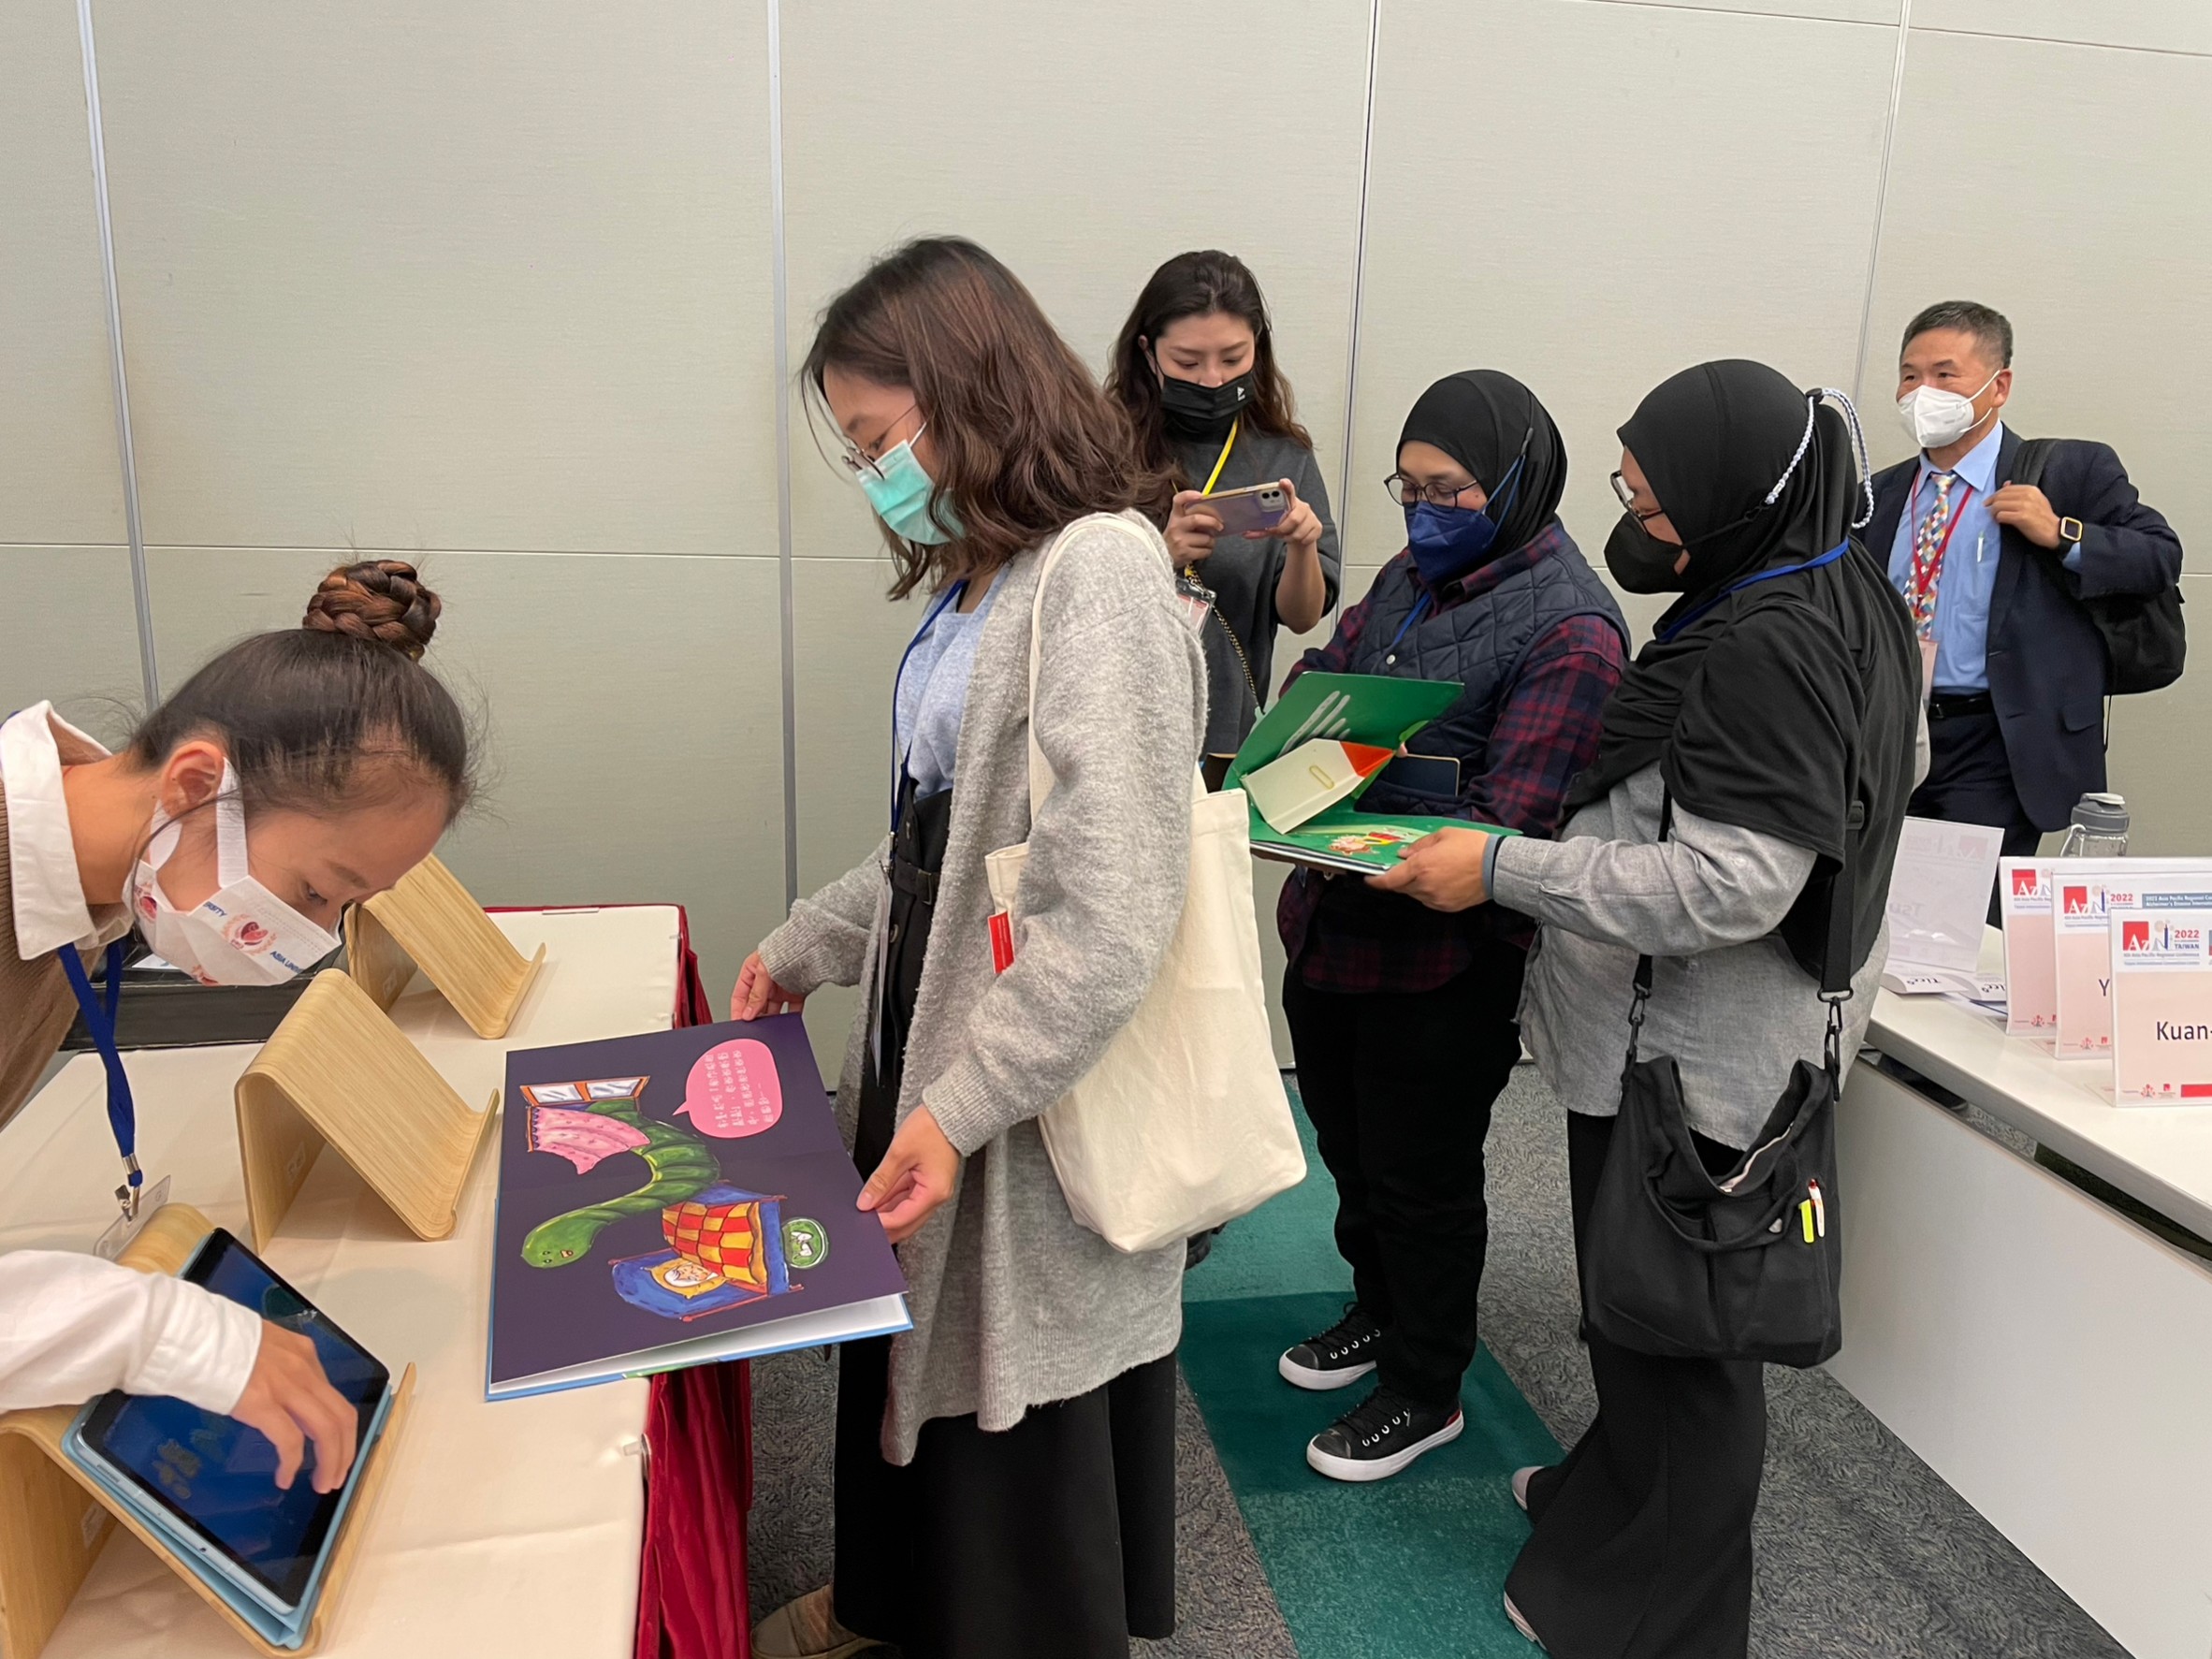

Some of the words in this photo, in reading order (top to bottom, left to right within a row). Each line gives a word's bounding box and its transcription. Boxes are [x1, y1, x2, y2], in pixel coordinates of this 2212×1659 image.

[2110, 894, 2133, 902] 2022
[2175, 929, 2200, 939] 2022
[269, 951, 287, 964] ASIA
[2157, 1021, 2212, 1041] Kuan
